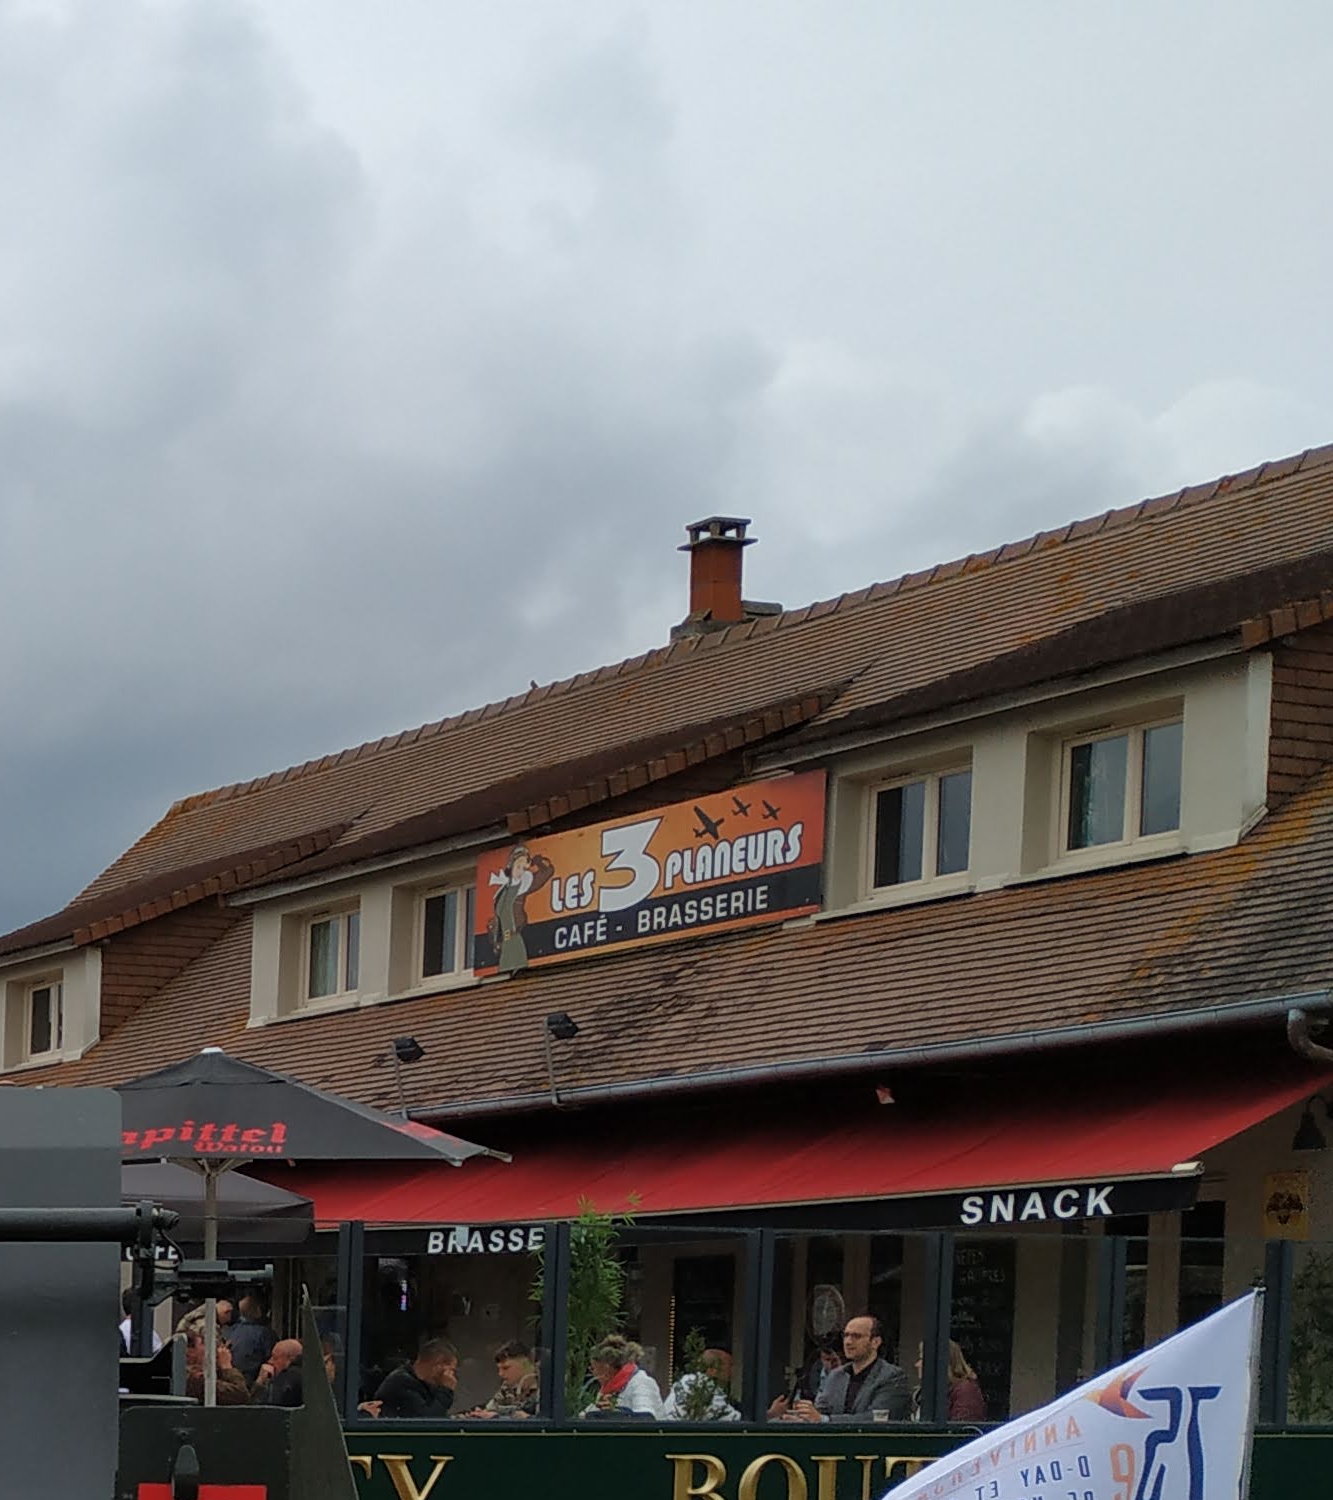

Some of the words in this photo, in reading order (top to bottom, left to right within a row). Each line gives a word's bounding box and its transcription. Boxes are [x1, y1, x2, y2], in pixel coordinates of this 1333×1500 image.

[551, 868, 596, 913] LES
[598, 816, 664, 913] 3
[663, 821, 804, 890] PLANEURS
[554, 914, 607, 949] CAFÉ
[637, 885, 768, 933] BRASSERIE
[960, 1185, 1115, 1225] SNACK
